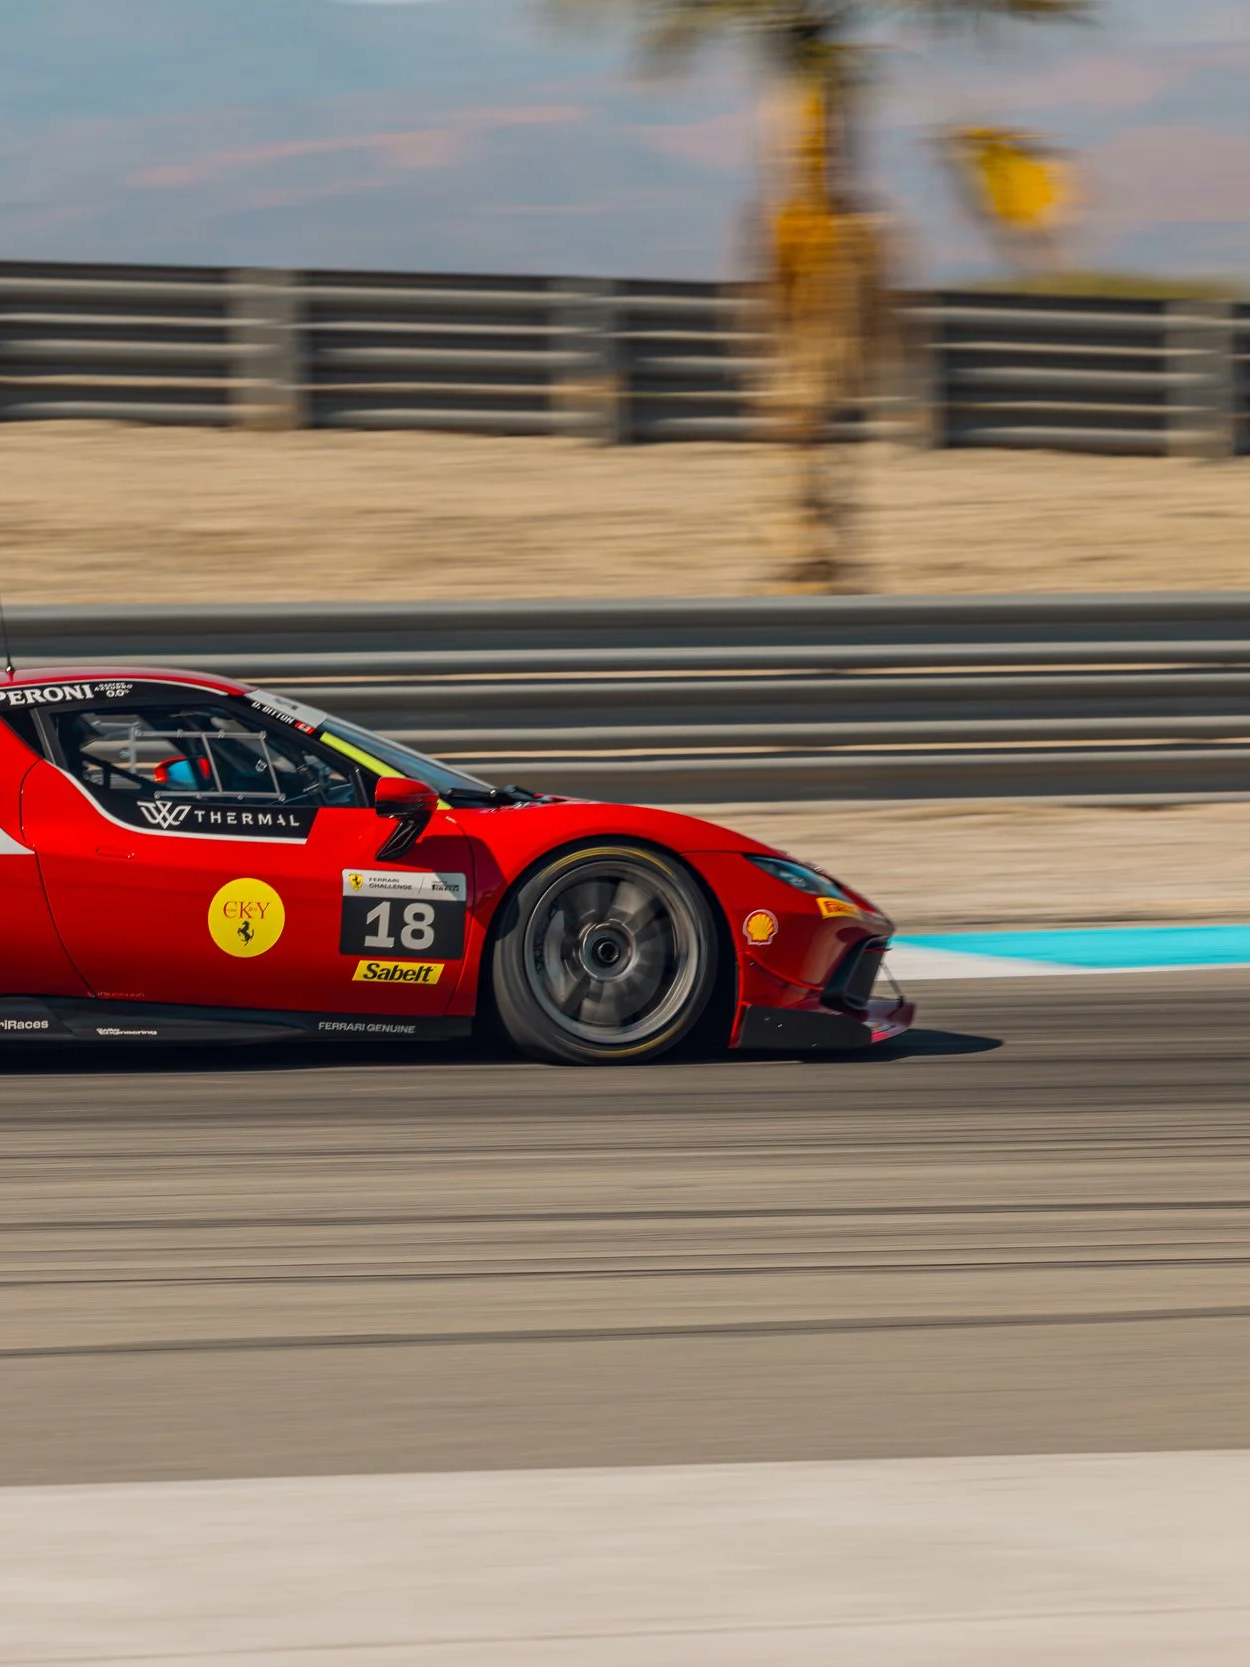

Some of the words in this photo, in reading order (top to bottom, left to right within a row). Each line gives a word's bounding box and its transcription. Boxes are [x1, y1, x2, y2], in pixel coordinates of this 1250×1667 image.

[194, 810, 300, 826] THERMAL
[364, 901, 435, 950] 18
[363, 963, 434, 982] Sabelt
[318, 1022, 366, 1031] FERRARI
[366, 1024, 416, 1034] GENUINE
